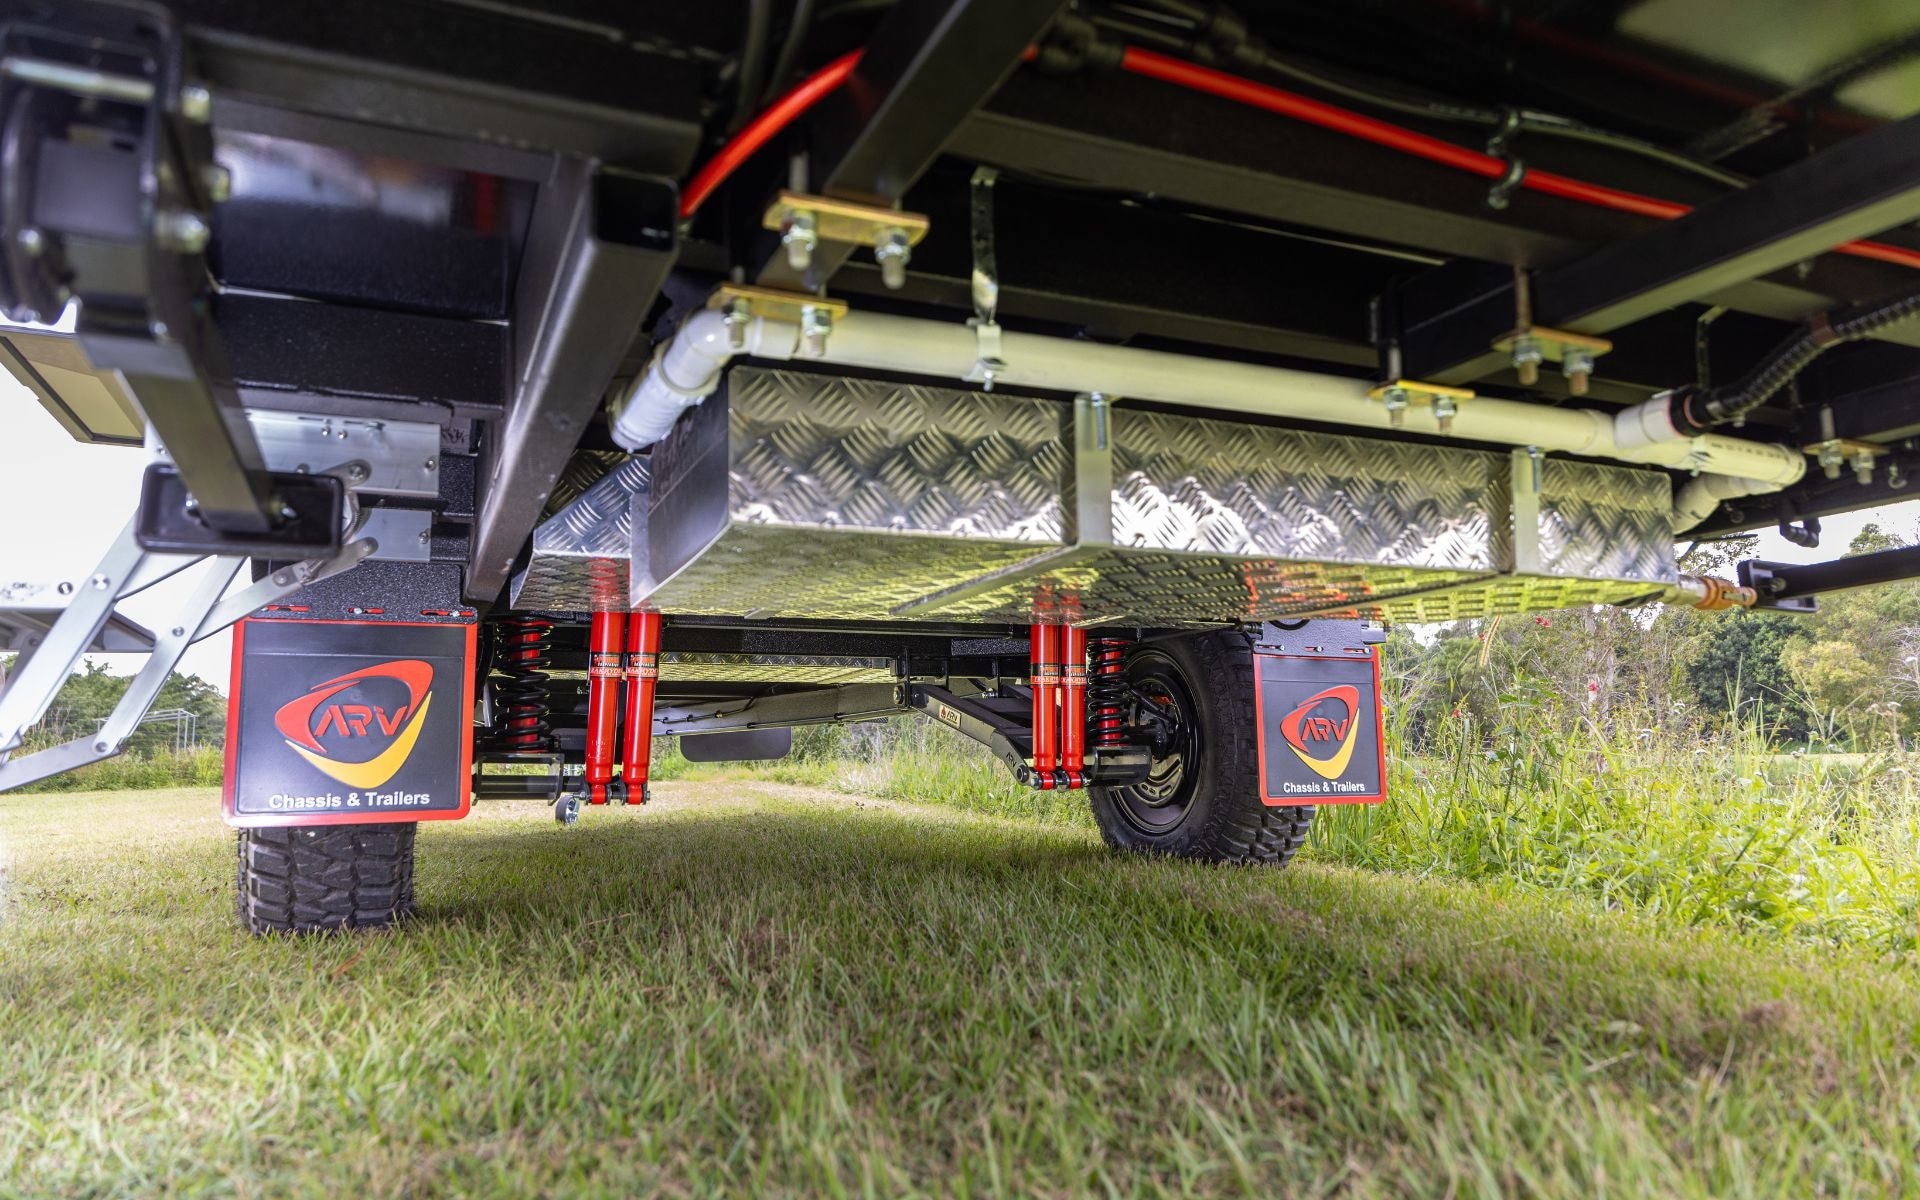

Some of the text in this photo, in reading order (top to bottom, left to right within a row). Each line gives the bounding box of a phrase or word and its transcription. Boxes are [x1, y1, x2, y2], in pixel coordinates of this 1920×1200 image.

[313, 704, 408, 737] ARV
[1301, 717, 1349, 742] ARV
[1283, 781, 1366, 793] Chassis & Trailers
[268, 791, 431, 809] Chassis & Trailers
